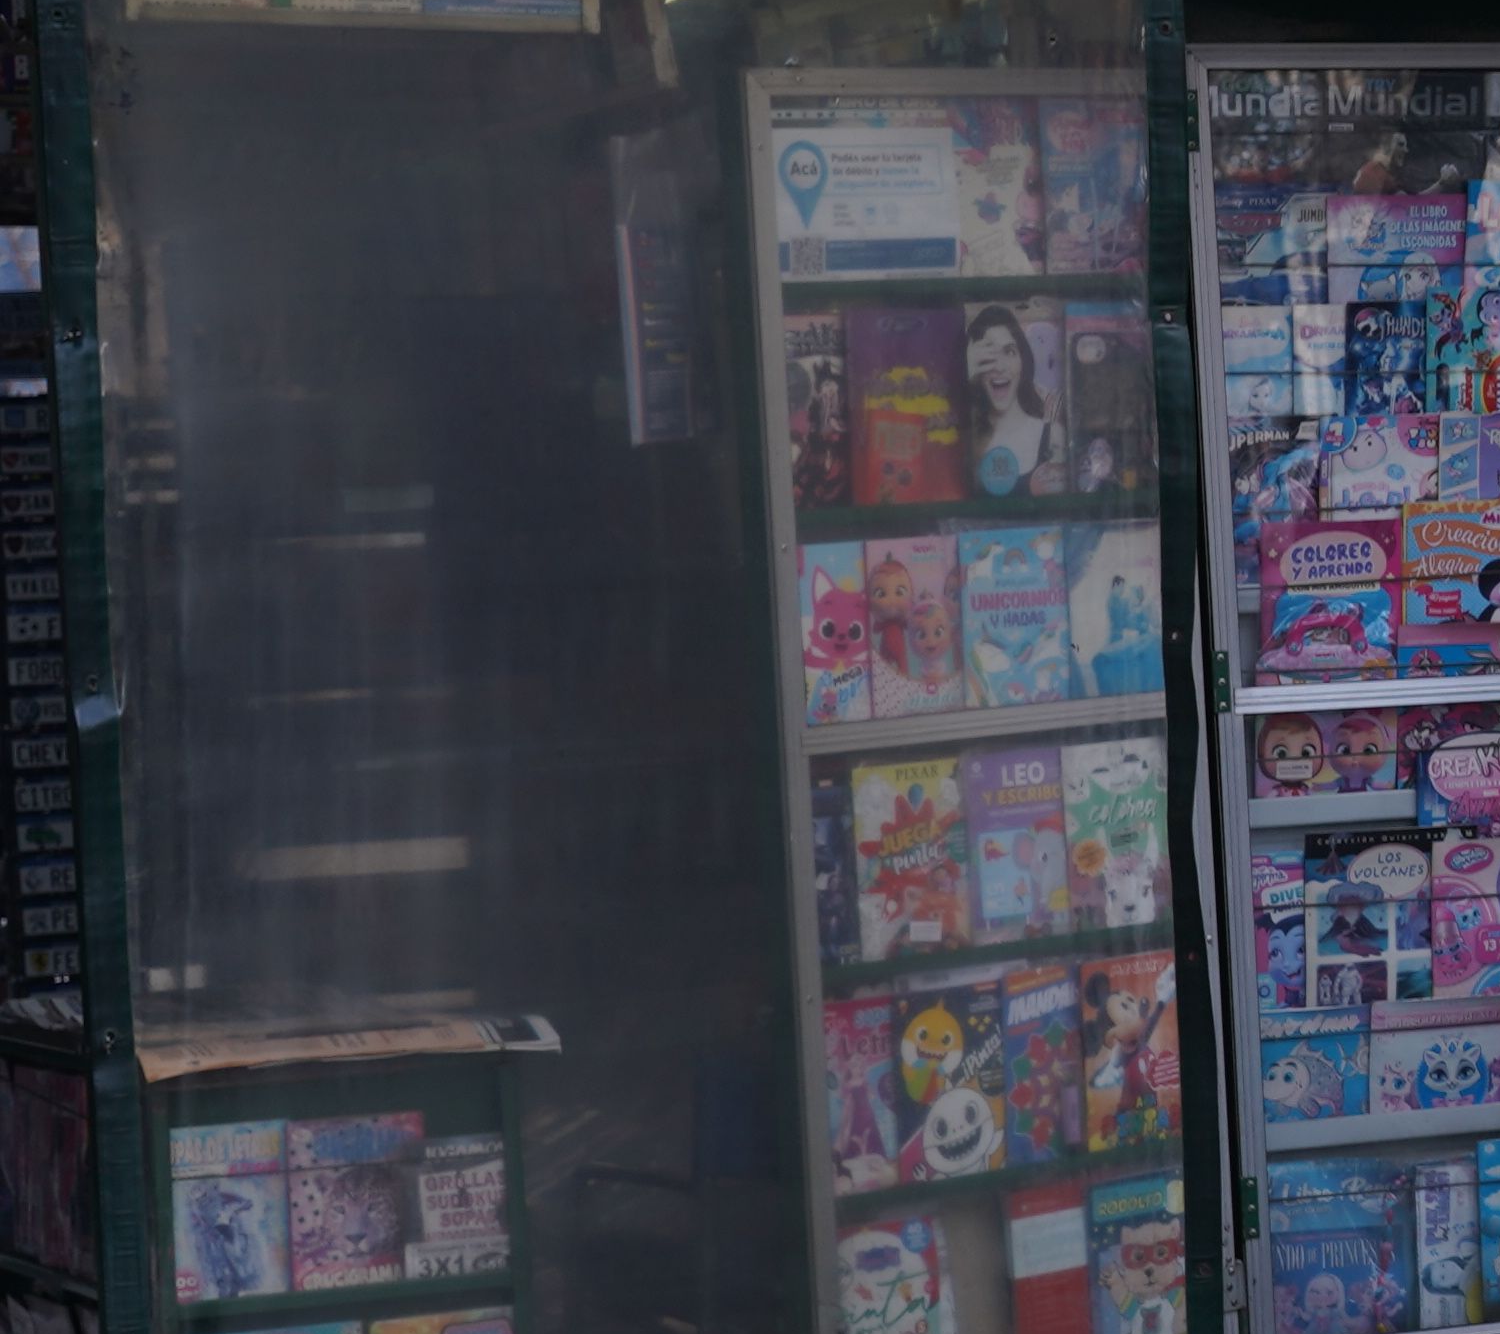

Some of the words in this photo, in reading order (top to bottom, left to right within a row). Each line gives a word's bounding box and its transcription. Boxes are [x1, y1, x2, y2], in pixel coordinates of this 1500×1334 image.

[1328, 85, 1478, 117] Mundial
[790, 159, 819, 177] Acá
[1410, 206, 1422, 217] EL
[1423, 205, 1448, 217] LIBRO
[1403, 220, 1421, 232] LAS
[1401, 235, 1458, 250] ESCONDIDAS
[1291, 541, 1372, 565] COLOREO
[1291, 568, 1302, 580] Y
[1307, 561, 1374, 579] APRENDO
[969, 588, 1066, 612] UNICORNIOS
[895, 765, 940, 783] PIXAR
[1001, 761, 1046, 788] LEO
[981, 790, 994, 805] Y
[1377, 852, 1402, 865] LOS
[1353, 864, 1424, 880] VOLCANES
[1483, 938, 1497, 952] 13
[1099, 1191, 1165, 1217] RODOLFO
